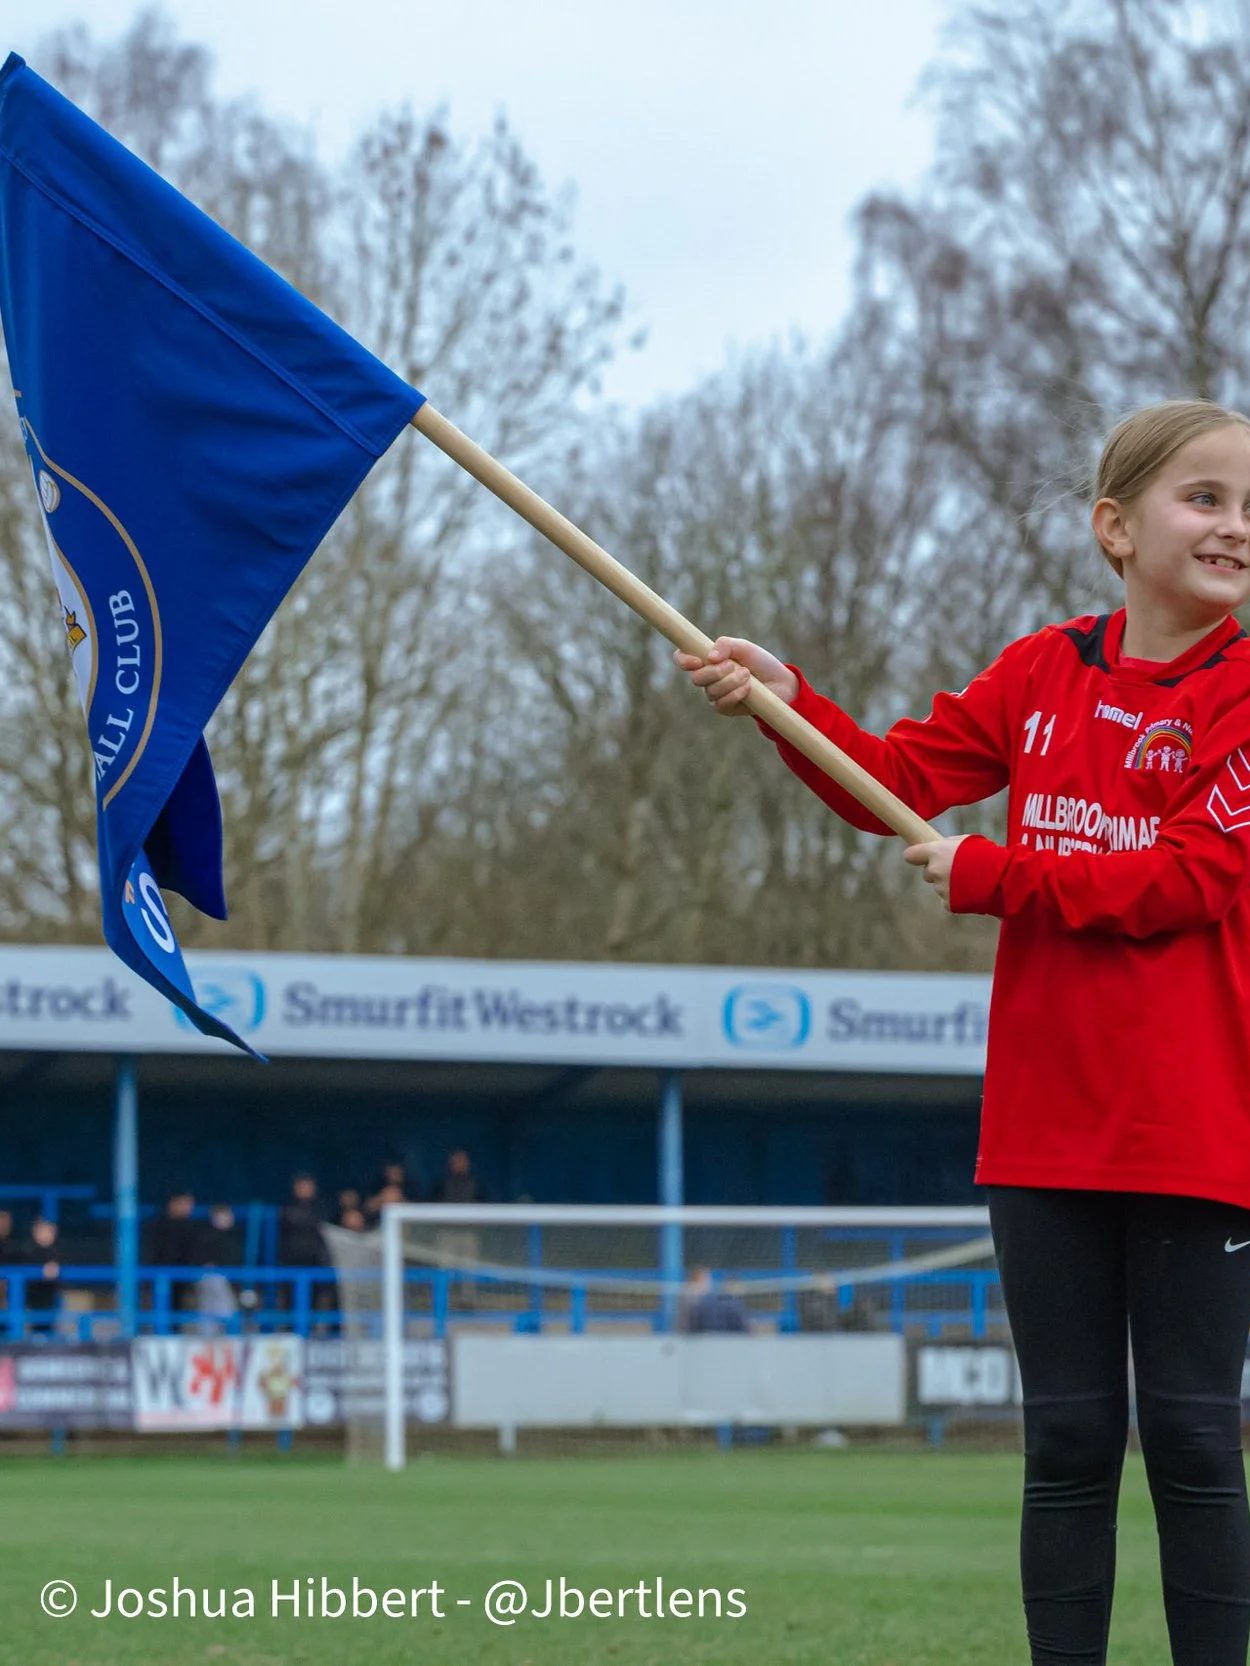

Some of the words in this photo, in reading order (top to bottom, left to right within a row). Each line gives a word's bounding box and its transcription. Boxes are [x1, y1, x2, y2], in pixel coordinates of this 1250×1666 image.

[108, 589, 141, 695] CLUB
[1024, 711, 1056, 756] 11
[0, 976, 132, 1022] trock
[826, 996, 988, 1045] Smurfi
